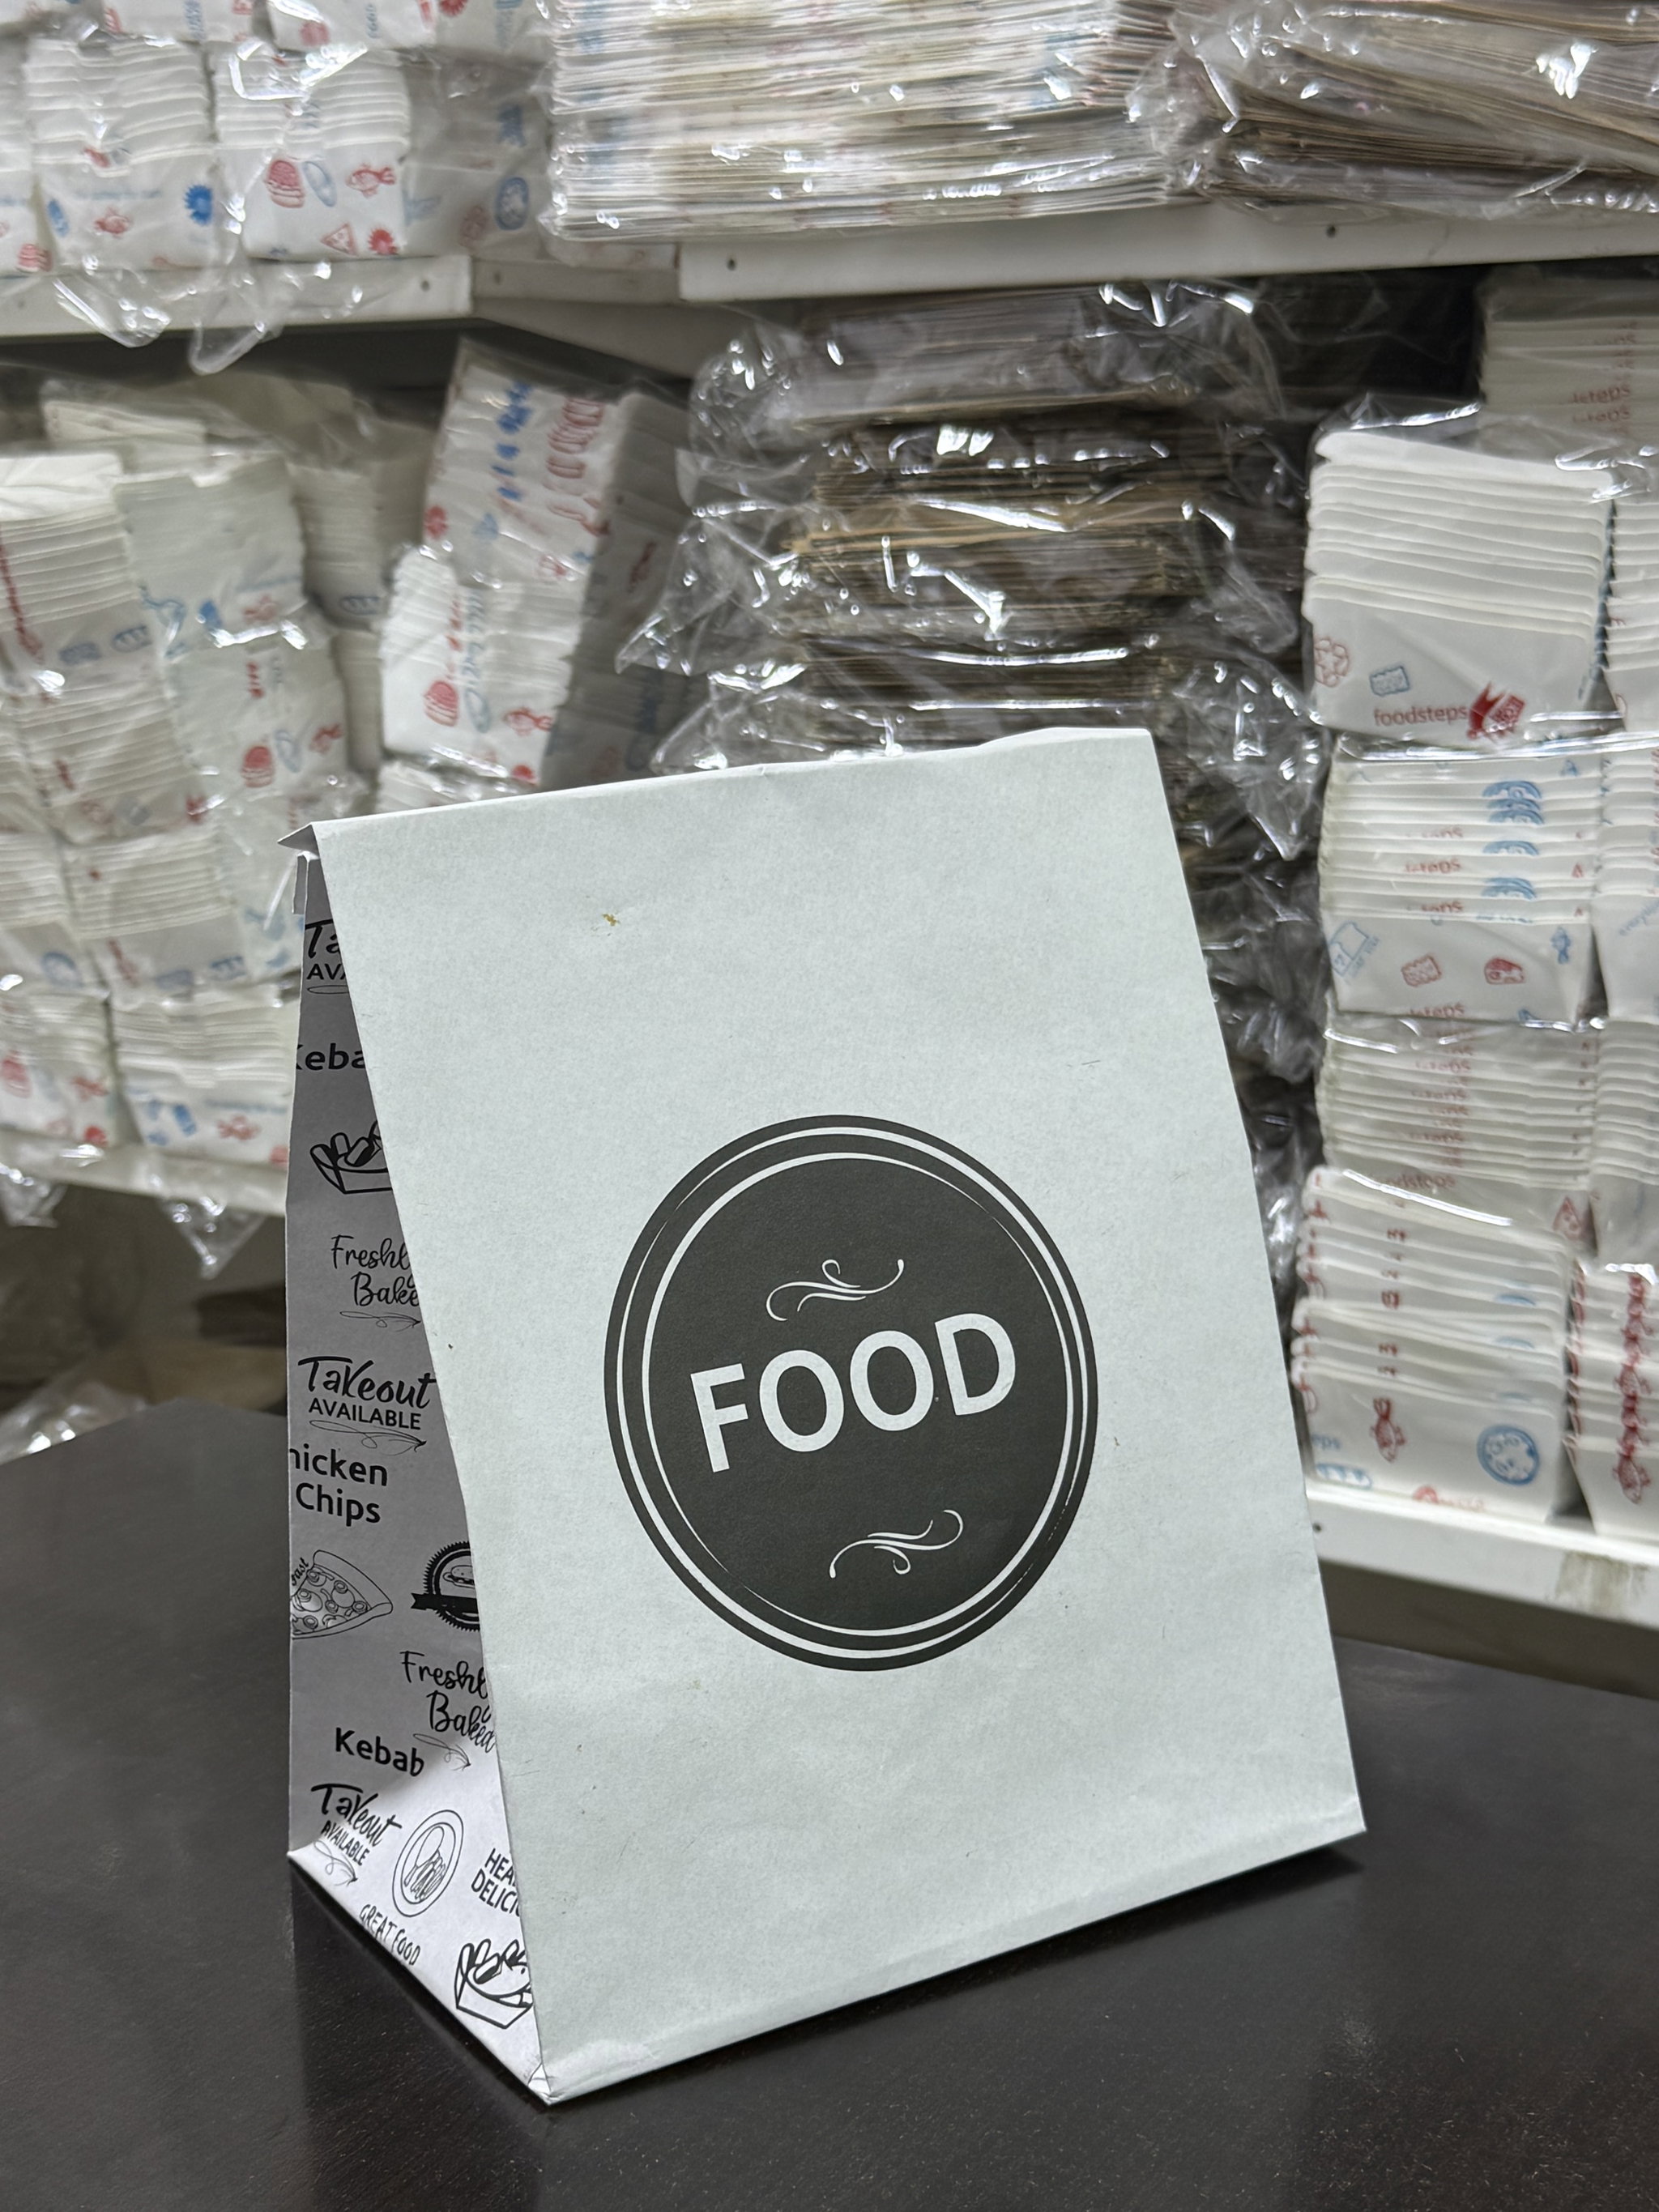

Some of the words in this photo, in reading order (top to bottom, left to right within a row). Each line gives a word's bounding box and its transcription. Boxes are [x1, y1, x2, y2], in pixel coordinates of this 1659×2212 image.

[1374, 705, 1467, 726] foodsteps
[297, 1355, 437, 1409] Takeout
[690, 1313, 1017, 1473] FOOD
[309, 1397, 422, 1430] AVAILABLE
[296, 1482, 382, 1527] Chips
[335, 1727, 425, 1777] Kebab
[310, 1783, 403, 1848] Takeout
[320, 1820, 370, 1866] AVAILABLE
[484, 1848, 516, 1887] HEA
[471, 1868, 520, 1917] DELICI
[360, 1903, 397, 1942] GREAT
[391, 1929, 420, 1966] FOOD
